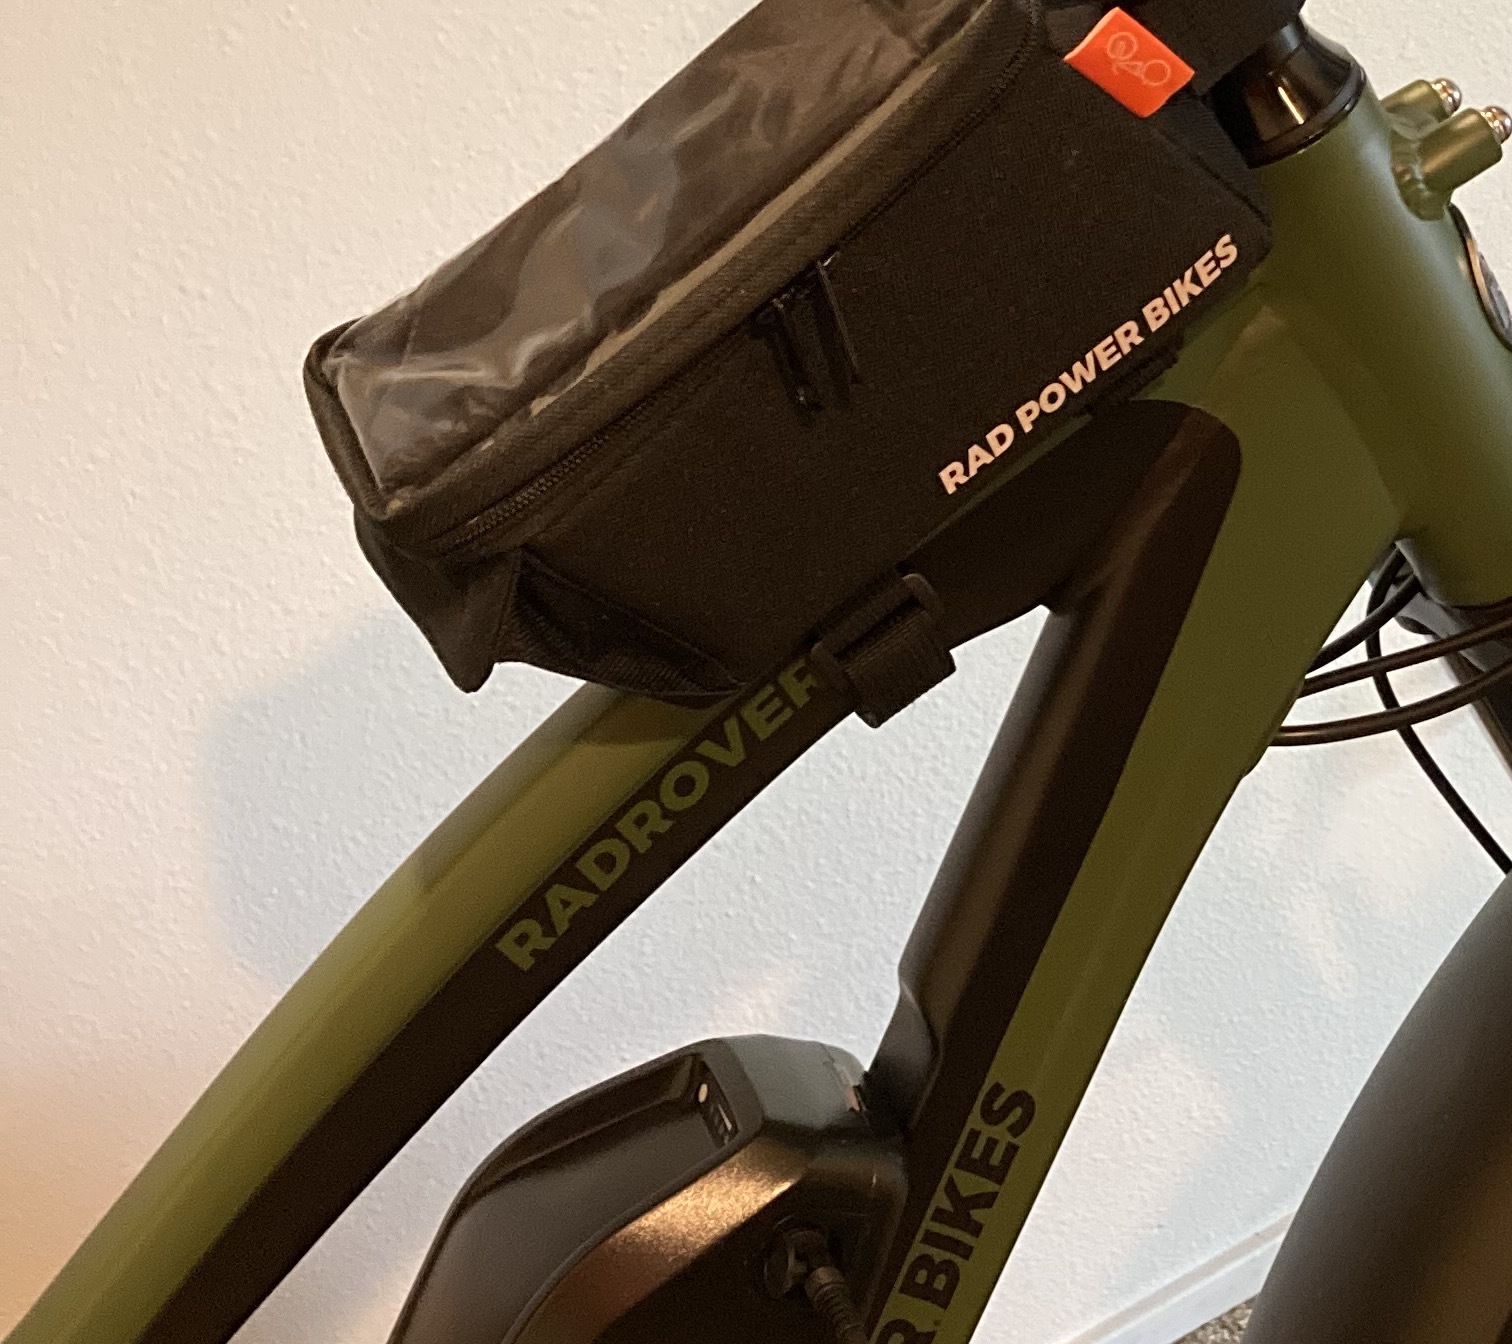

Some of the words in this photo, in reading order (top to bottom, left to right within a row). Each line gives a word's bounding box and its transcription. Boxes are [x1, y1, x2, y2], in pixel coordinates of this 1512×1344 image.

[938, 423, 1014, 494] RAD
[1015, 320, 1144, 433] POWER
[1141, 234, 1238, 332] BIKES
[898, 1083, 1037, 1311] BIKES
